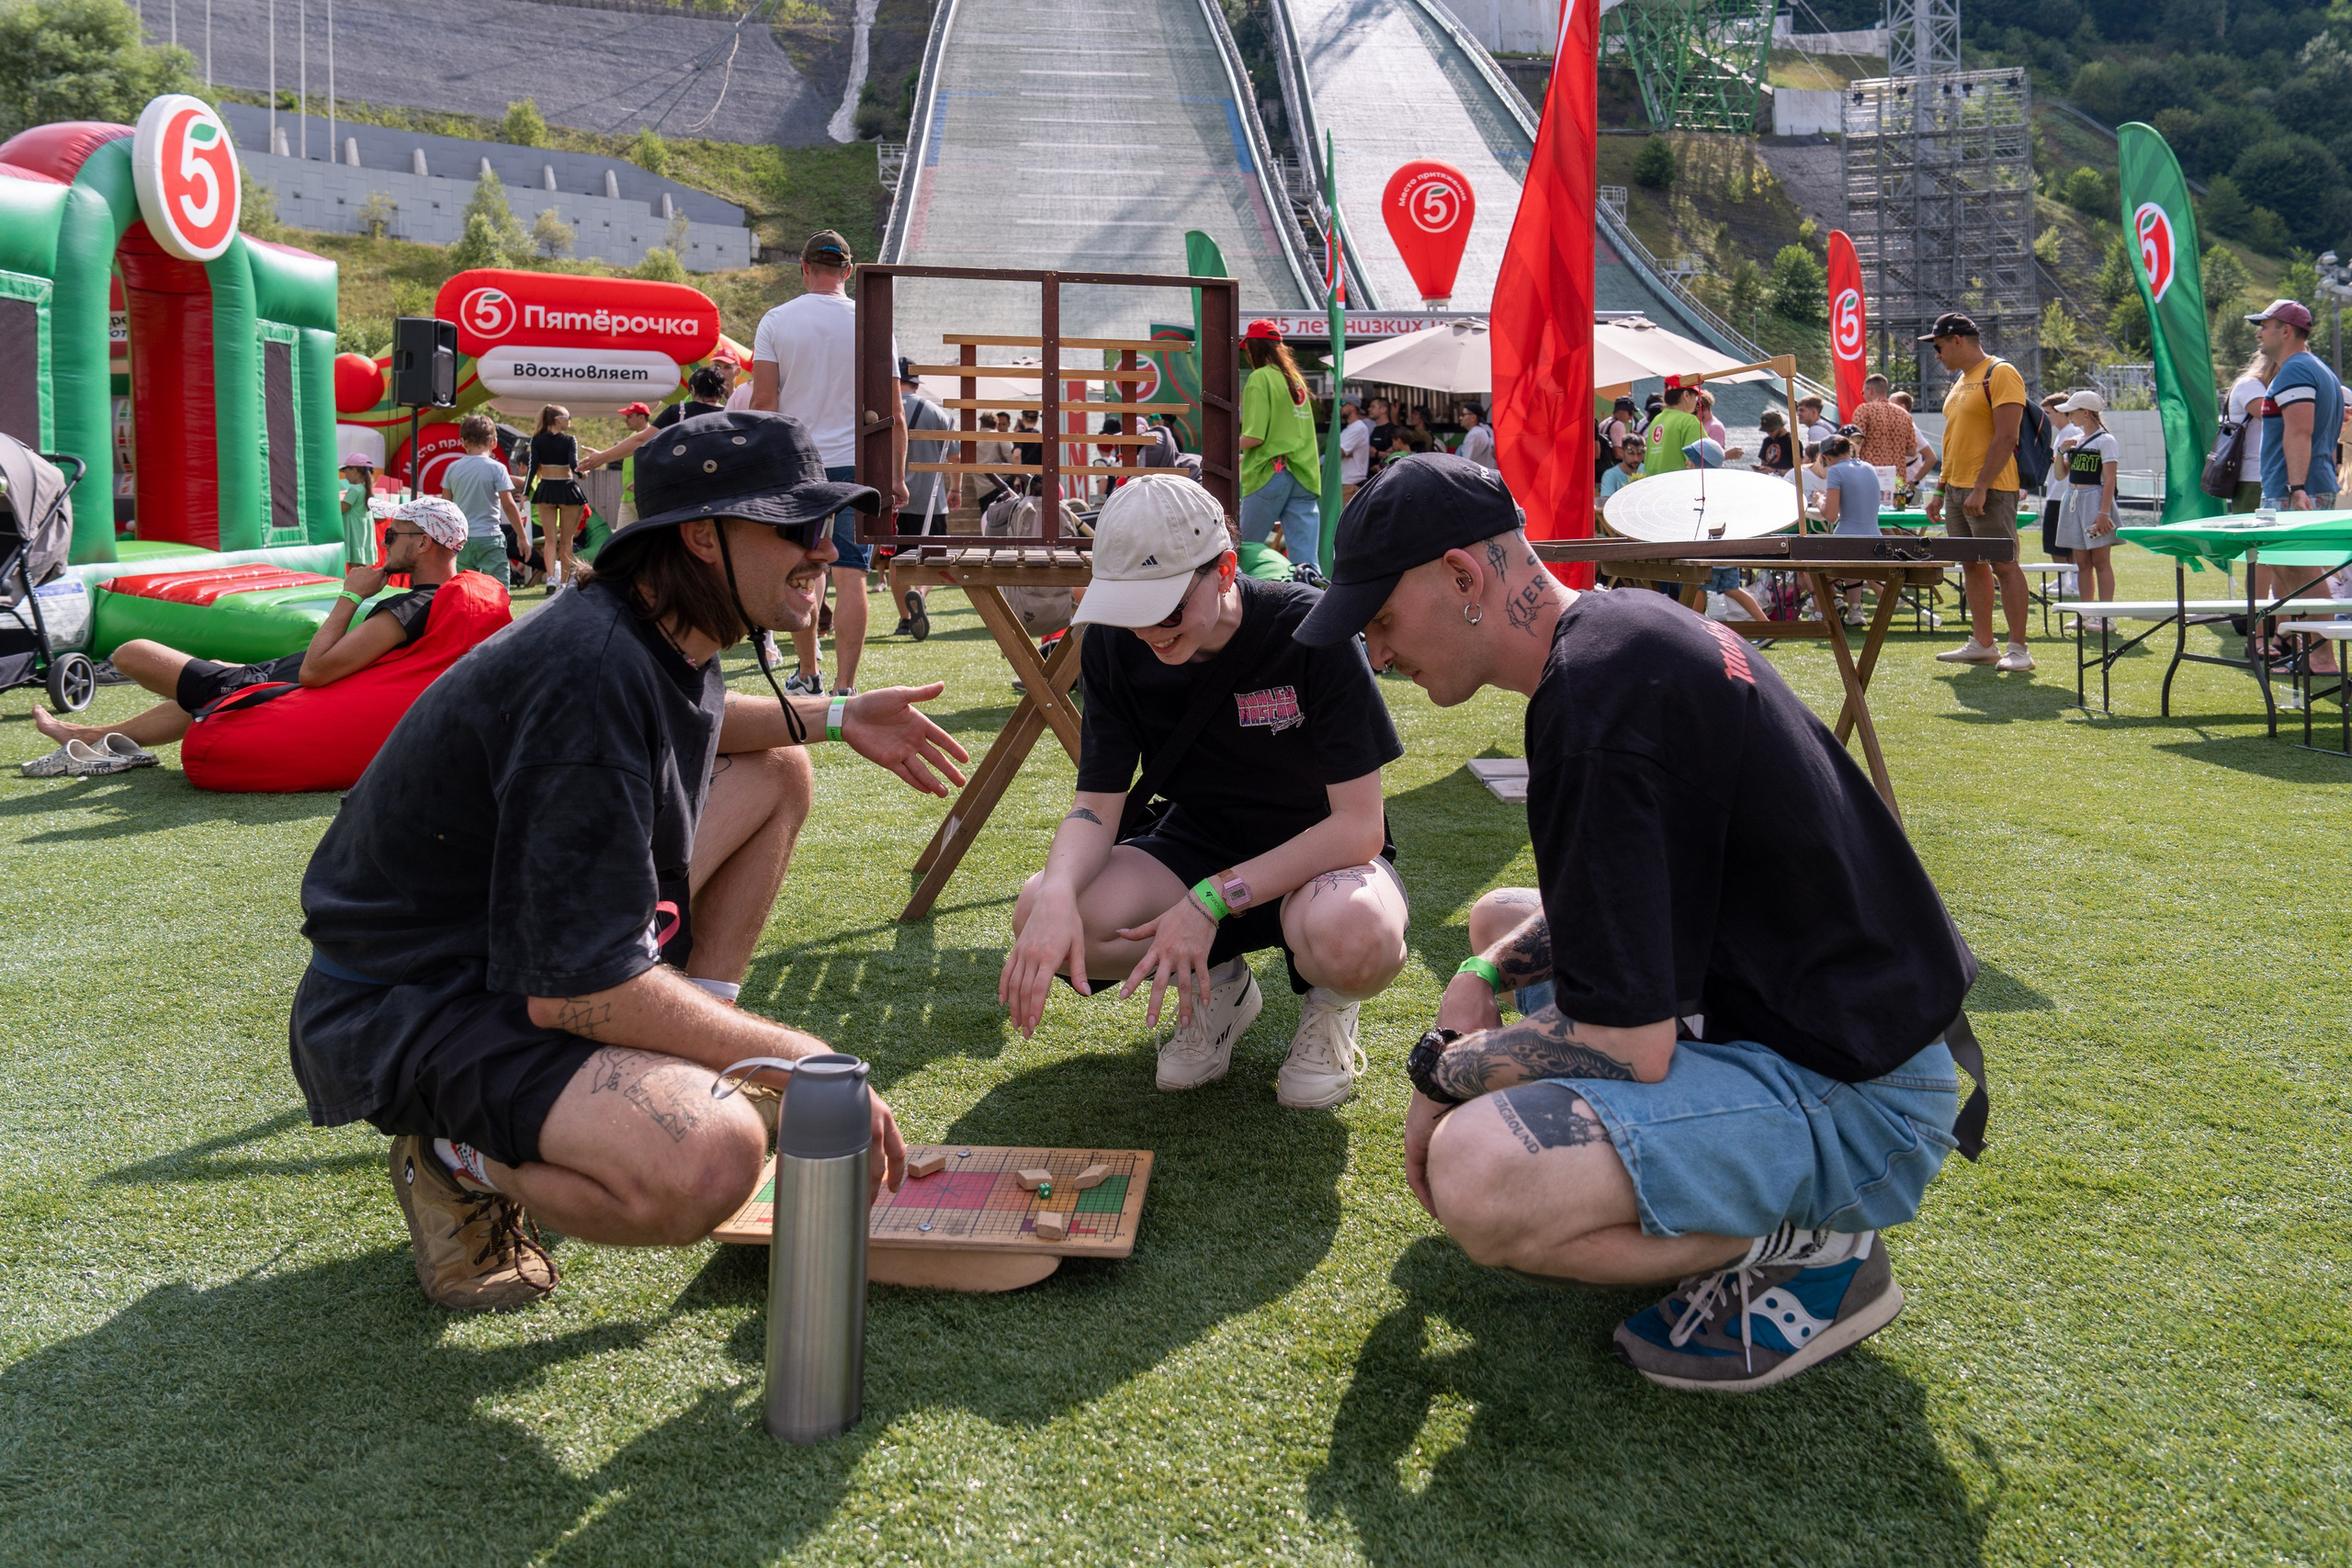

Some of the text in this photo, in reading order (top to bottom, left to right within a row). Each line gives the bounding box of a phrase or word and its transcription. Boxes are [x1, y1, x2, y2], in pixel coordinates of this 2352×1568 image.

[179, 115, 221, 228] 5
[1398, 172, 1467, 207] Место притяжения
[1423, 186, 1449, 223] 5
[474, 291, 698, 337] 5 Пятёрочка
[1344, 319, 1424, 334] низких
[1840, 294, 1859, 347] 5
[513, 363, 649, 380] Вдохновляет
[1238, 703, 1301, 727] NASCAR
